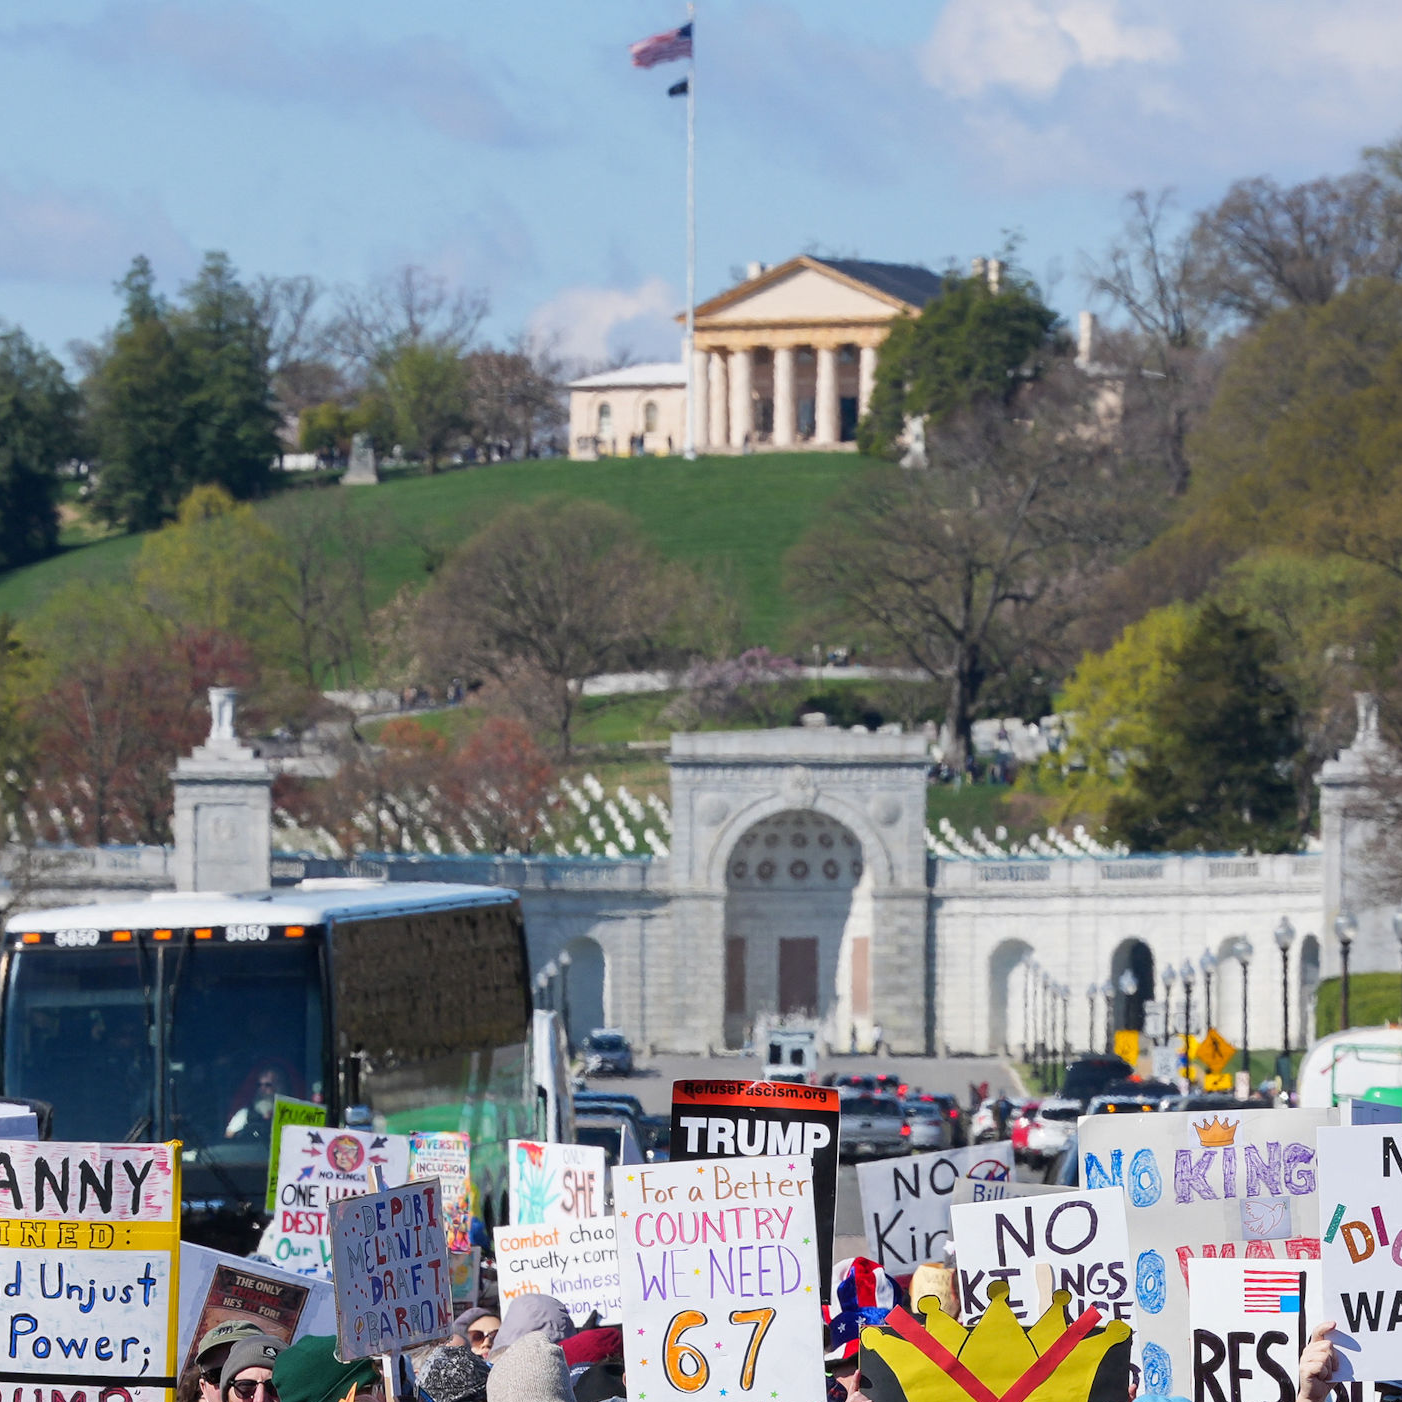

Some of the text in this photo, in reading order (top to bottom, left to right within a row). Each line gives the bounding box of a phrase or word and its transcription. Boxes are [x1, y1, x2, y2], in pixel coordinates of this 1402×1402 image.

[684, 1081, 828, 1103] RefuseFascism.org
[680, 1116, 831, 1158] TRUMP
[318, 1171, 366, 1183] NO KINGS
[416, 1162, 466, 1175] INCLUSION
[640, 1165, 811, 1204] For a Better
[893, 1158, 959, 1201] NO
[1084, 1141, 1318, 1208] NO KING
[281, 1184, 319, 1207] ONE
[561, 1169, 598, 1220] SHE
[500, 1224, 615, 1252] combat chao
[634, 1206, 794, 1248] COUNTRY
[995, 1200, 1099, 1268] NO
[347, 1225, 439, 1279] MELANIA
[510, 1251, 569, 1274] cruelty
[637, 1244, 802, 1302] WE NEED
[40, 1261, 157, 1314] Unjust
[235, 1275, 283, 1296] THE ONLY
[371, 1259, 442, 1306] DRAFT
[9, 1311, 151, 1377] Power;
